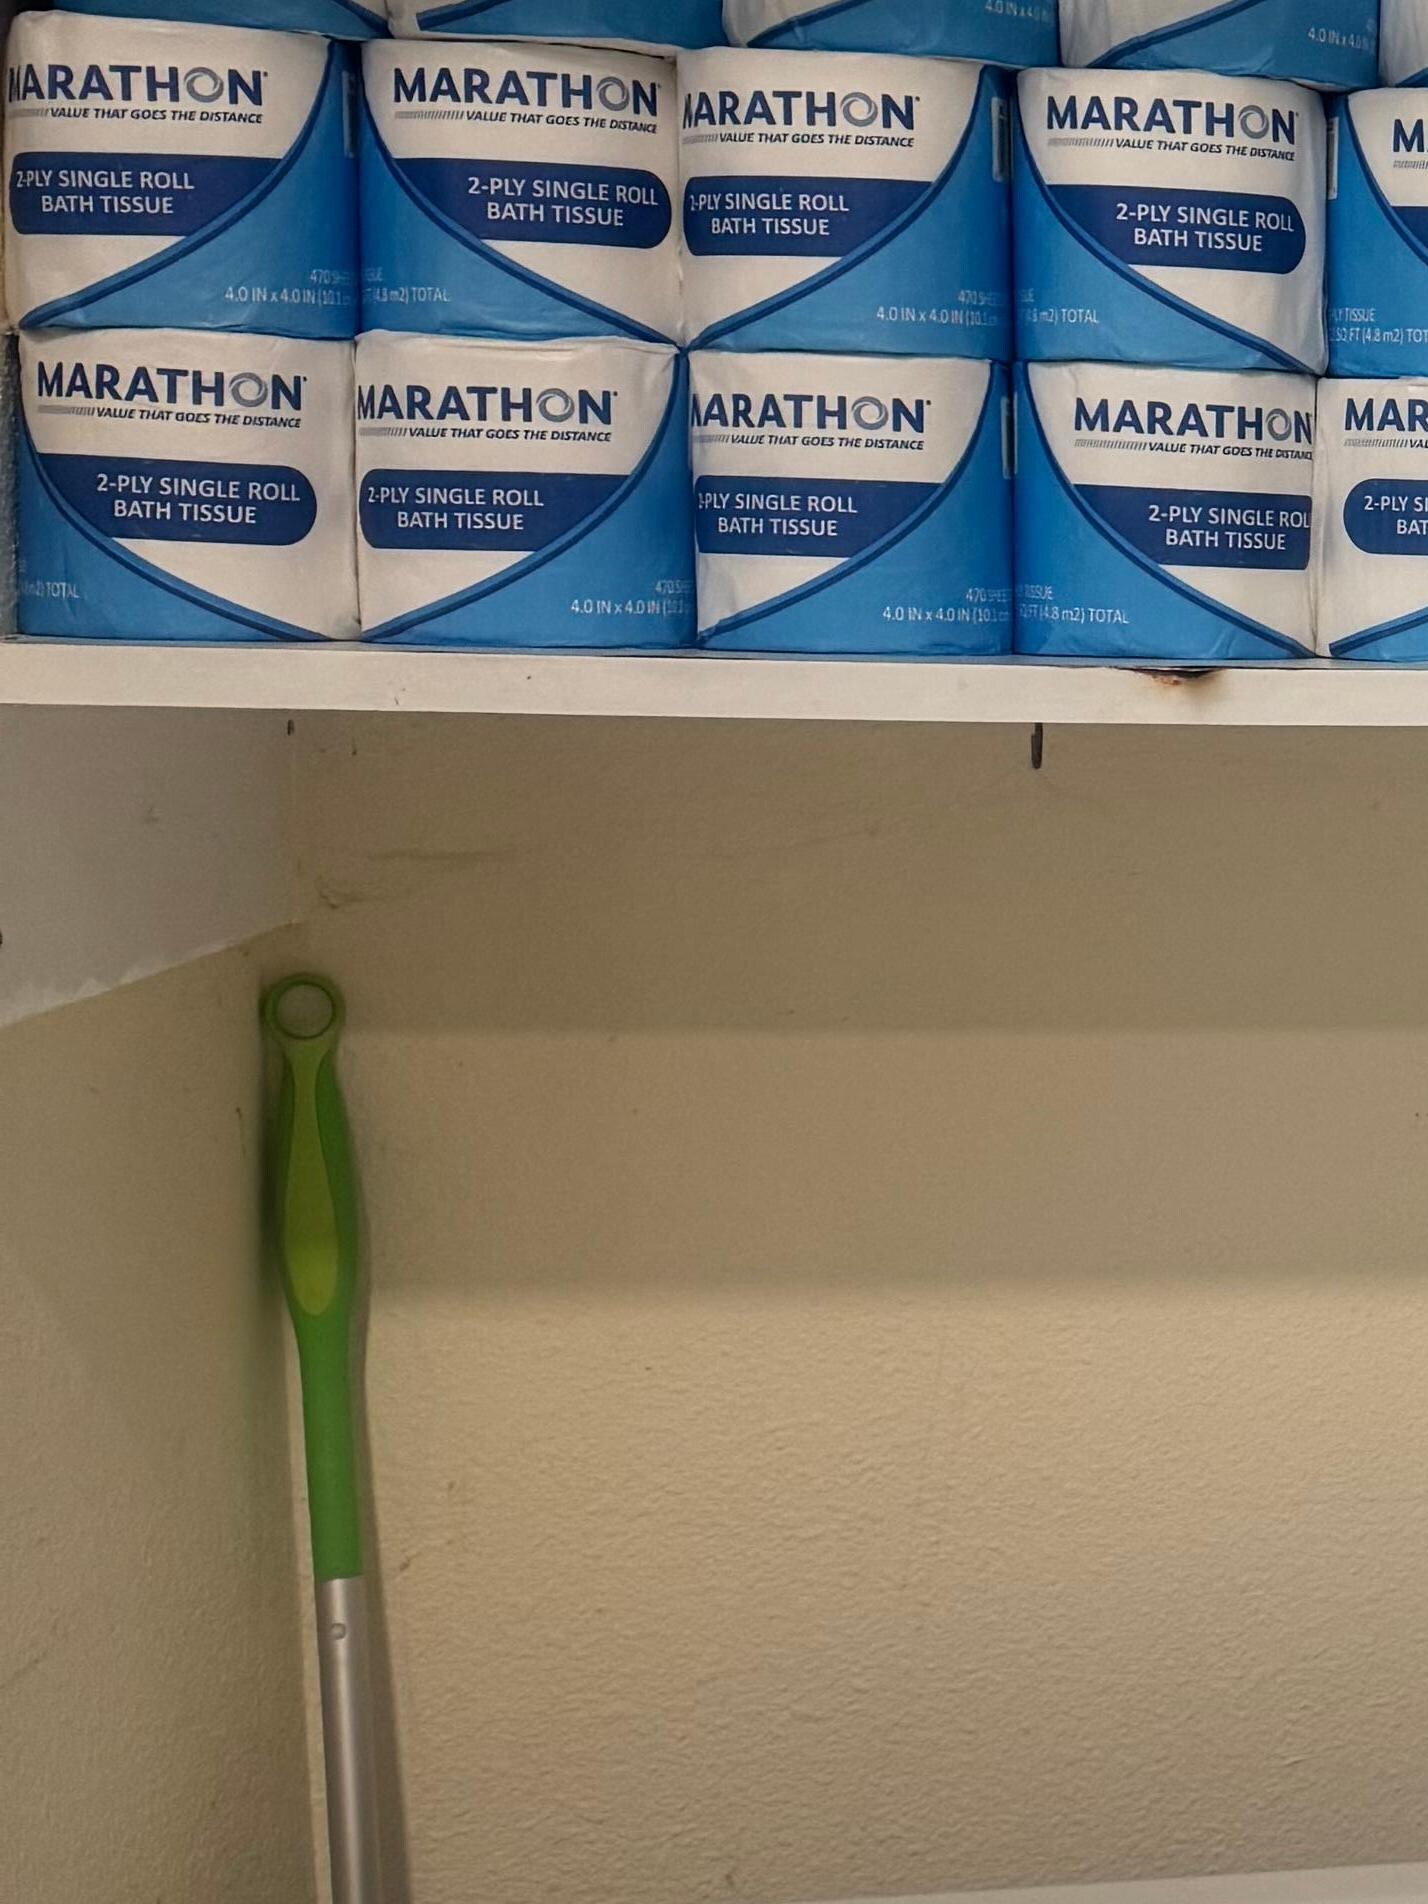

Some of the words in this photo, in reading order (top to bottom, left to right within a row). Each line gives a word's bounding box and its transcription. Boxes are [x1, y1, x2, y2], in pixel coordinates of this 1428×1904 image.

[393, 67, 657, 116] MARATHON
[1047, 96, 1295, 144] MARATHON
[468, 177, 525, 196] 2-PLY
[532, 179, 608, 200] SINGLE
[616, 185, 658, 205] ROLL
[487, 204, 544, 221] BATH
[552, 206, 624, 226] TISSUE
[37, 361, 302, 411] MARATHON
[357, 385, 612, 425] MARATHON
[409, 428, 448, 438] VALUE
[452, 429, 483, 439] THAT
[486, 429, 519, 440] GOES
[523, 430, 546, 440] THE
[551, 431, 611, 442] DISTANCE
[1074, 397, 1313, 445] MARATHON
[96, 473, 152, 493] 2-PLY
[159, 477, 240, 499] SINGLE
[249, 483, 300, 501] ROLL
[114, 501, 171, 520] BATH
[179, 503, 256, 524] TISSUE
[571, 599, 593, 614] 4.0
[596, 600, 611, 614] IN
[625, 600, 644, 615] 4.0
[647, 601, 661, 615] IN
